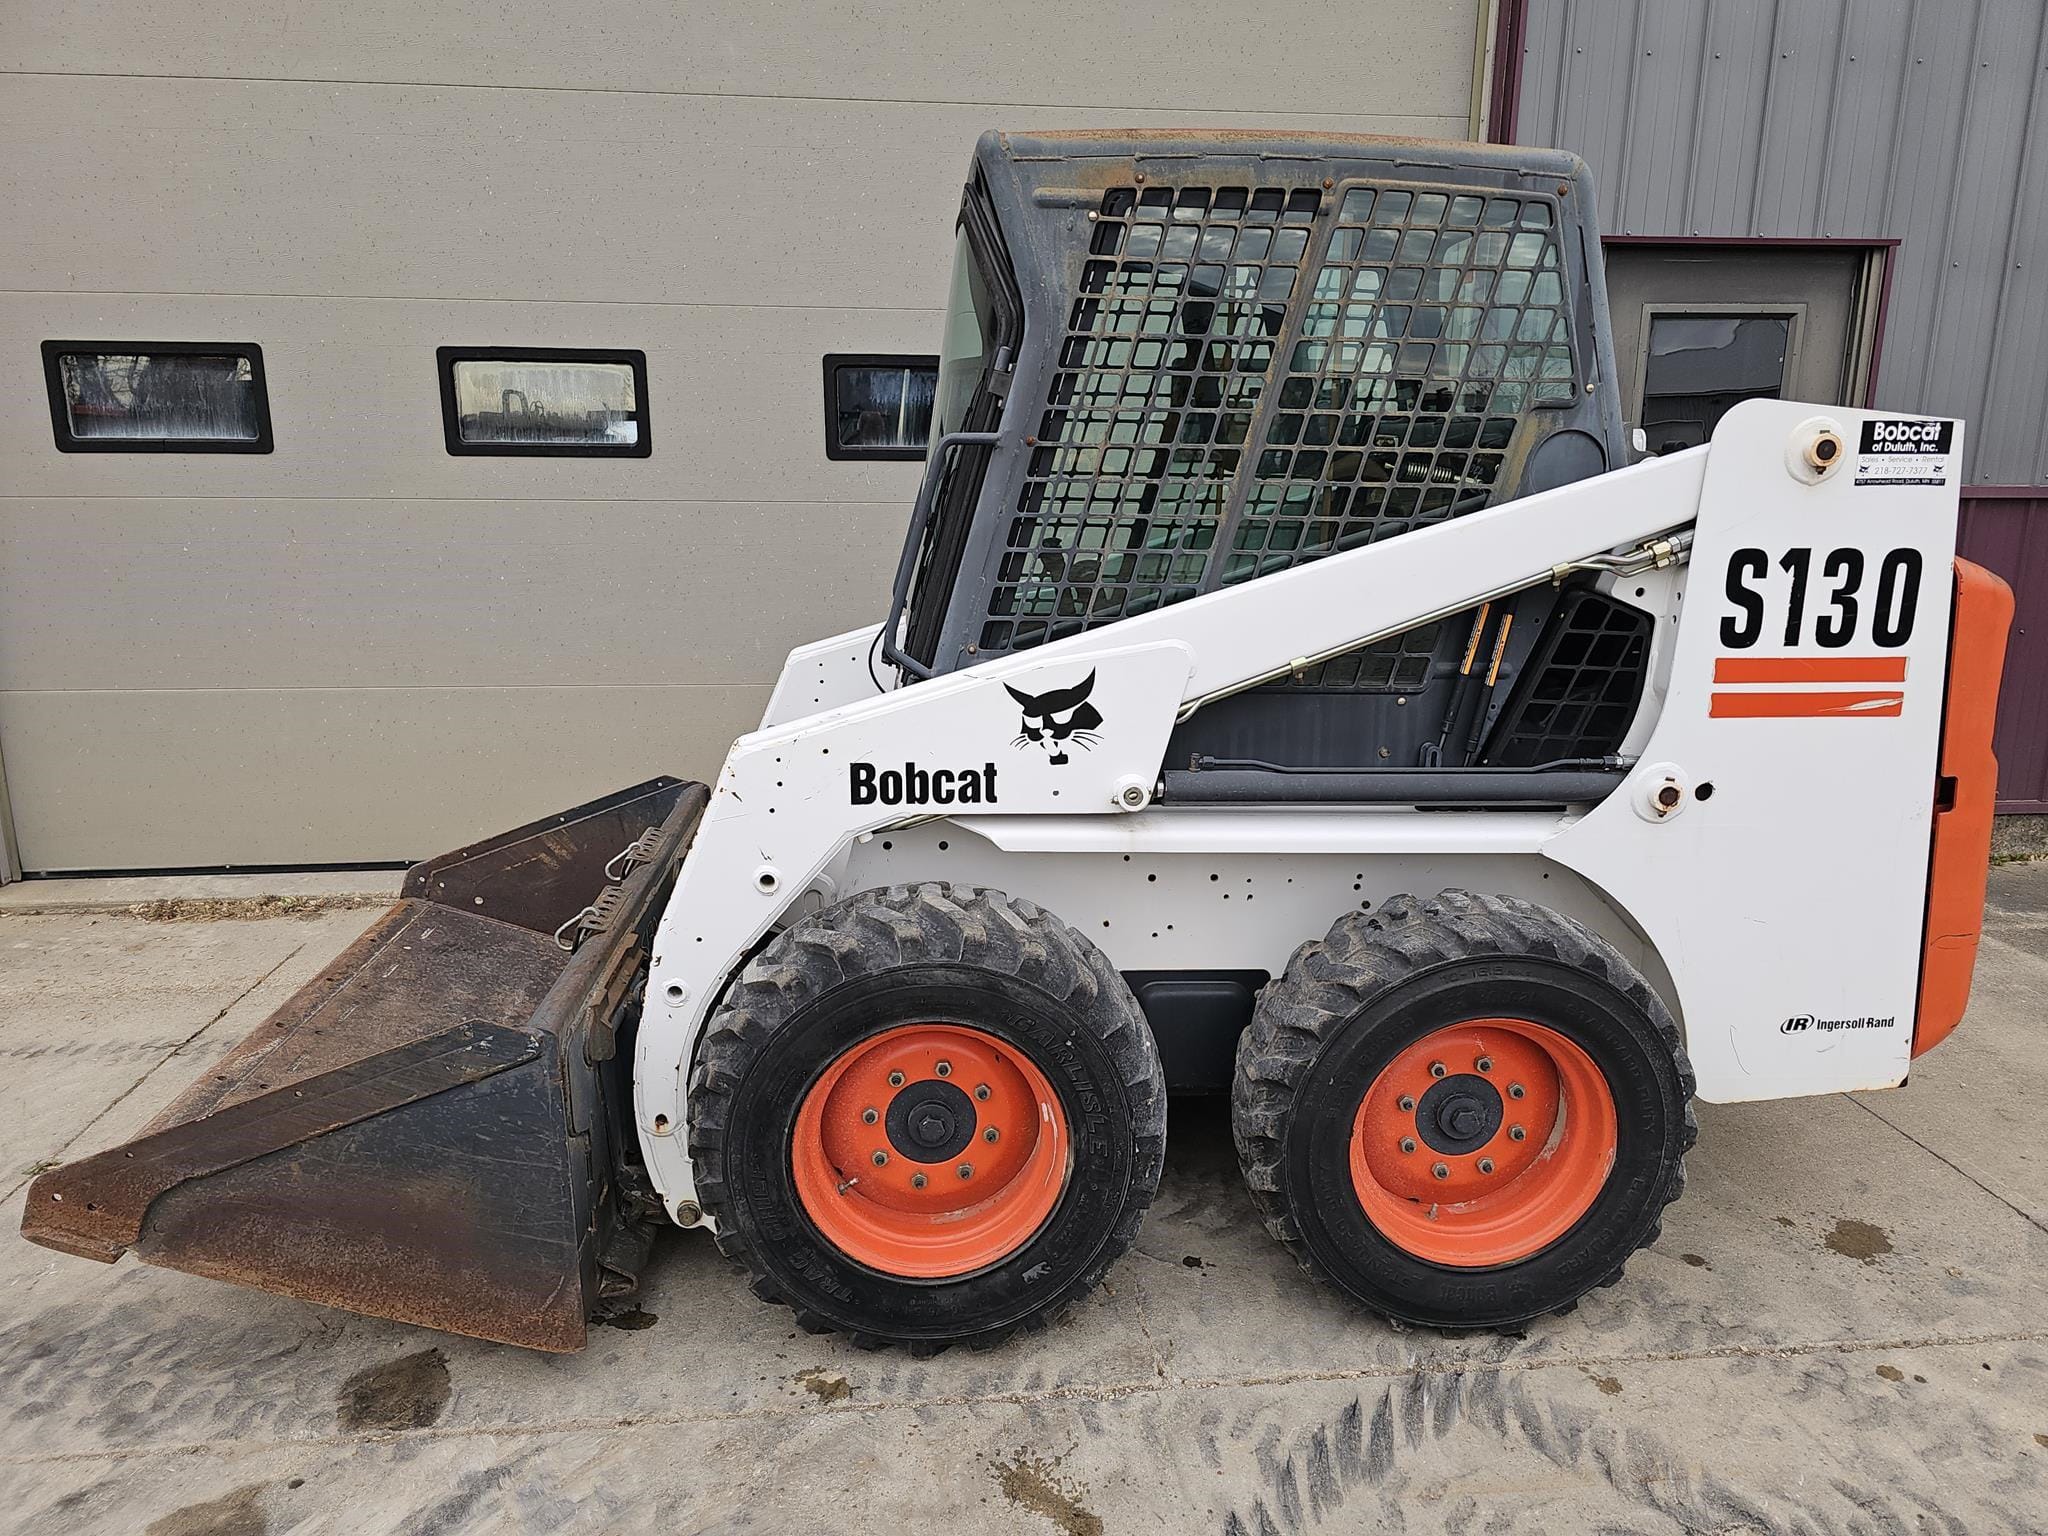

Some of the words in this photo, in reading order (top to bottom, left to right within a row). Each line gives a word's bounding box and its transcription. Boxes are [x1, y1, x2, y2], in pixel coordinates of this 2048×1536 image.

[1873, 421, 1942, 441] Bobcat
[1872, 442, 1883, 452] of
[1884, 442, 1918, 453] Duluth,
[1920, 442, 1939, 452] Inc.
[1861, 456, 1879, 464] Sales
[1888, 456, 1913, 464] Service
[1921, 456, 1945, 464] Rental
[1874, 466, 1928, 475] 218-727-7377
[1719, 547, 1923, 649] S130
[850, 762, 998, 805] Bobcat
[1006, 1013, 1108, 1157] CARLISLE
